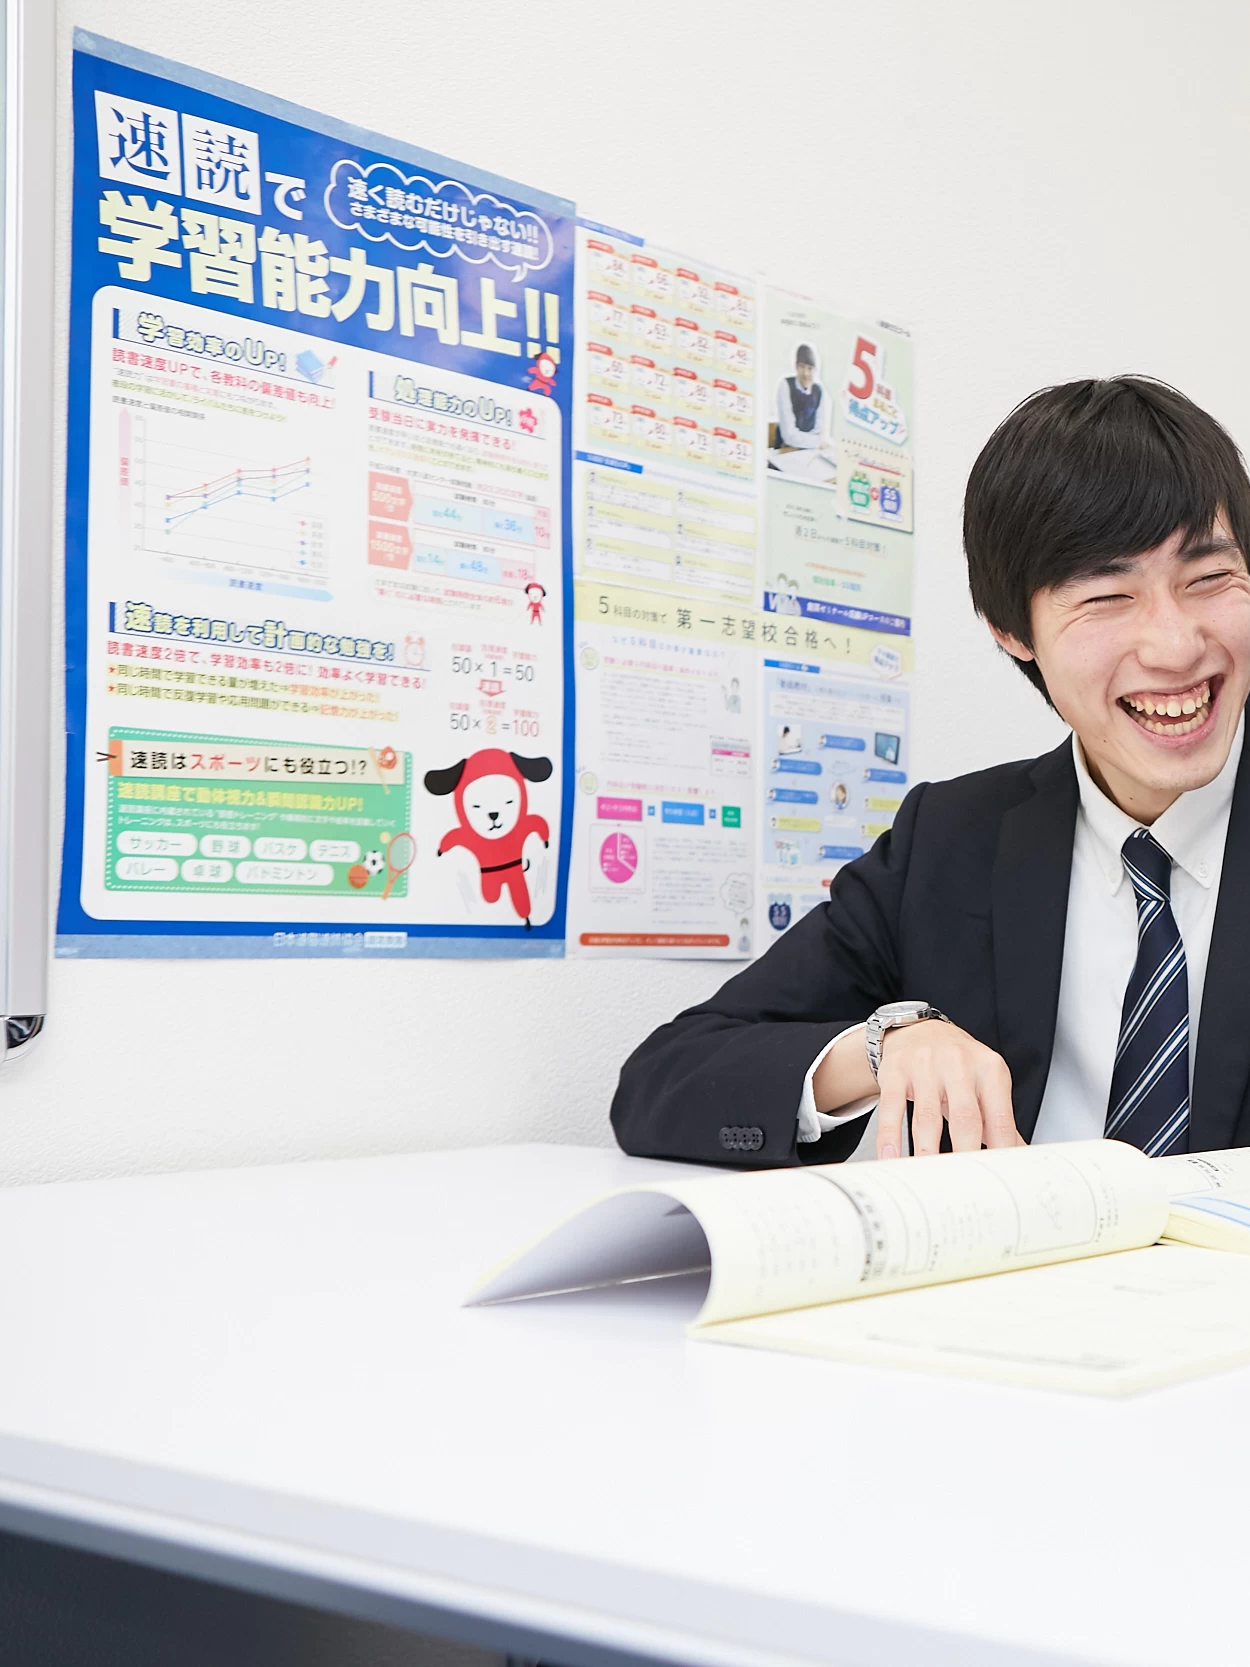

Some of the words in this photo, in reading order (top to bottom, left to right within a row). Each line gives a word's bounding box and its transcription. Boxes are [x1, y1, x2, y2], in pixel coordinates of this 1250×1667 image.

[107, 105, 306, 221] 速読で
[347, 176, 539, 244] 速く読むだけじゃない!!
[97, 189, 560, 365] 学習能力向上!!
[125, 600, 396, 662] 速読を利用して計画的な勉強を!
[129, 750, 368, 776] 速読はスポーツにも役立つ!?
[129, 836, 183, 851] サッカー
